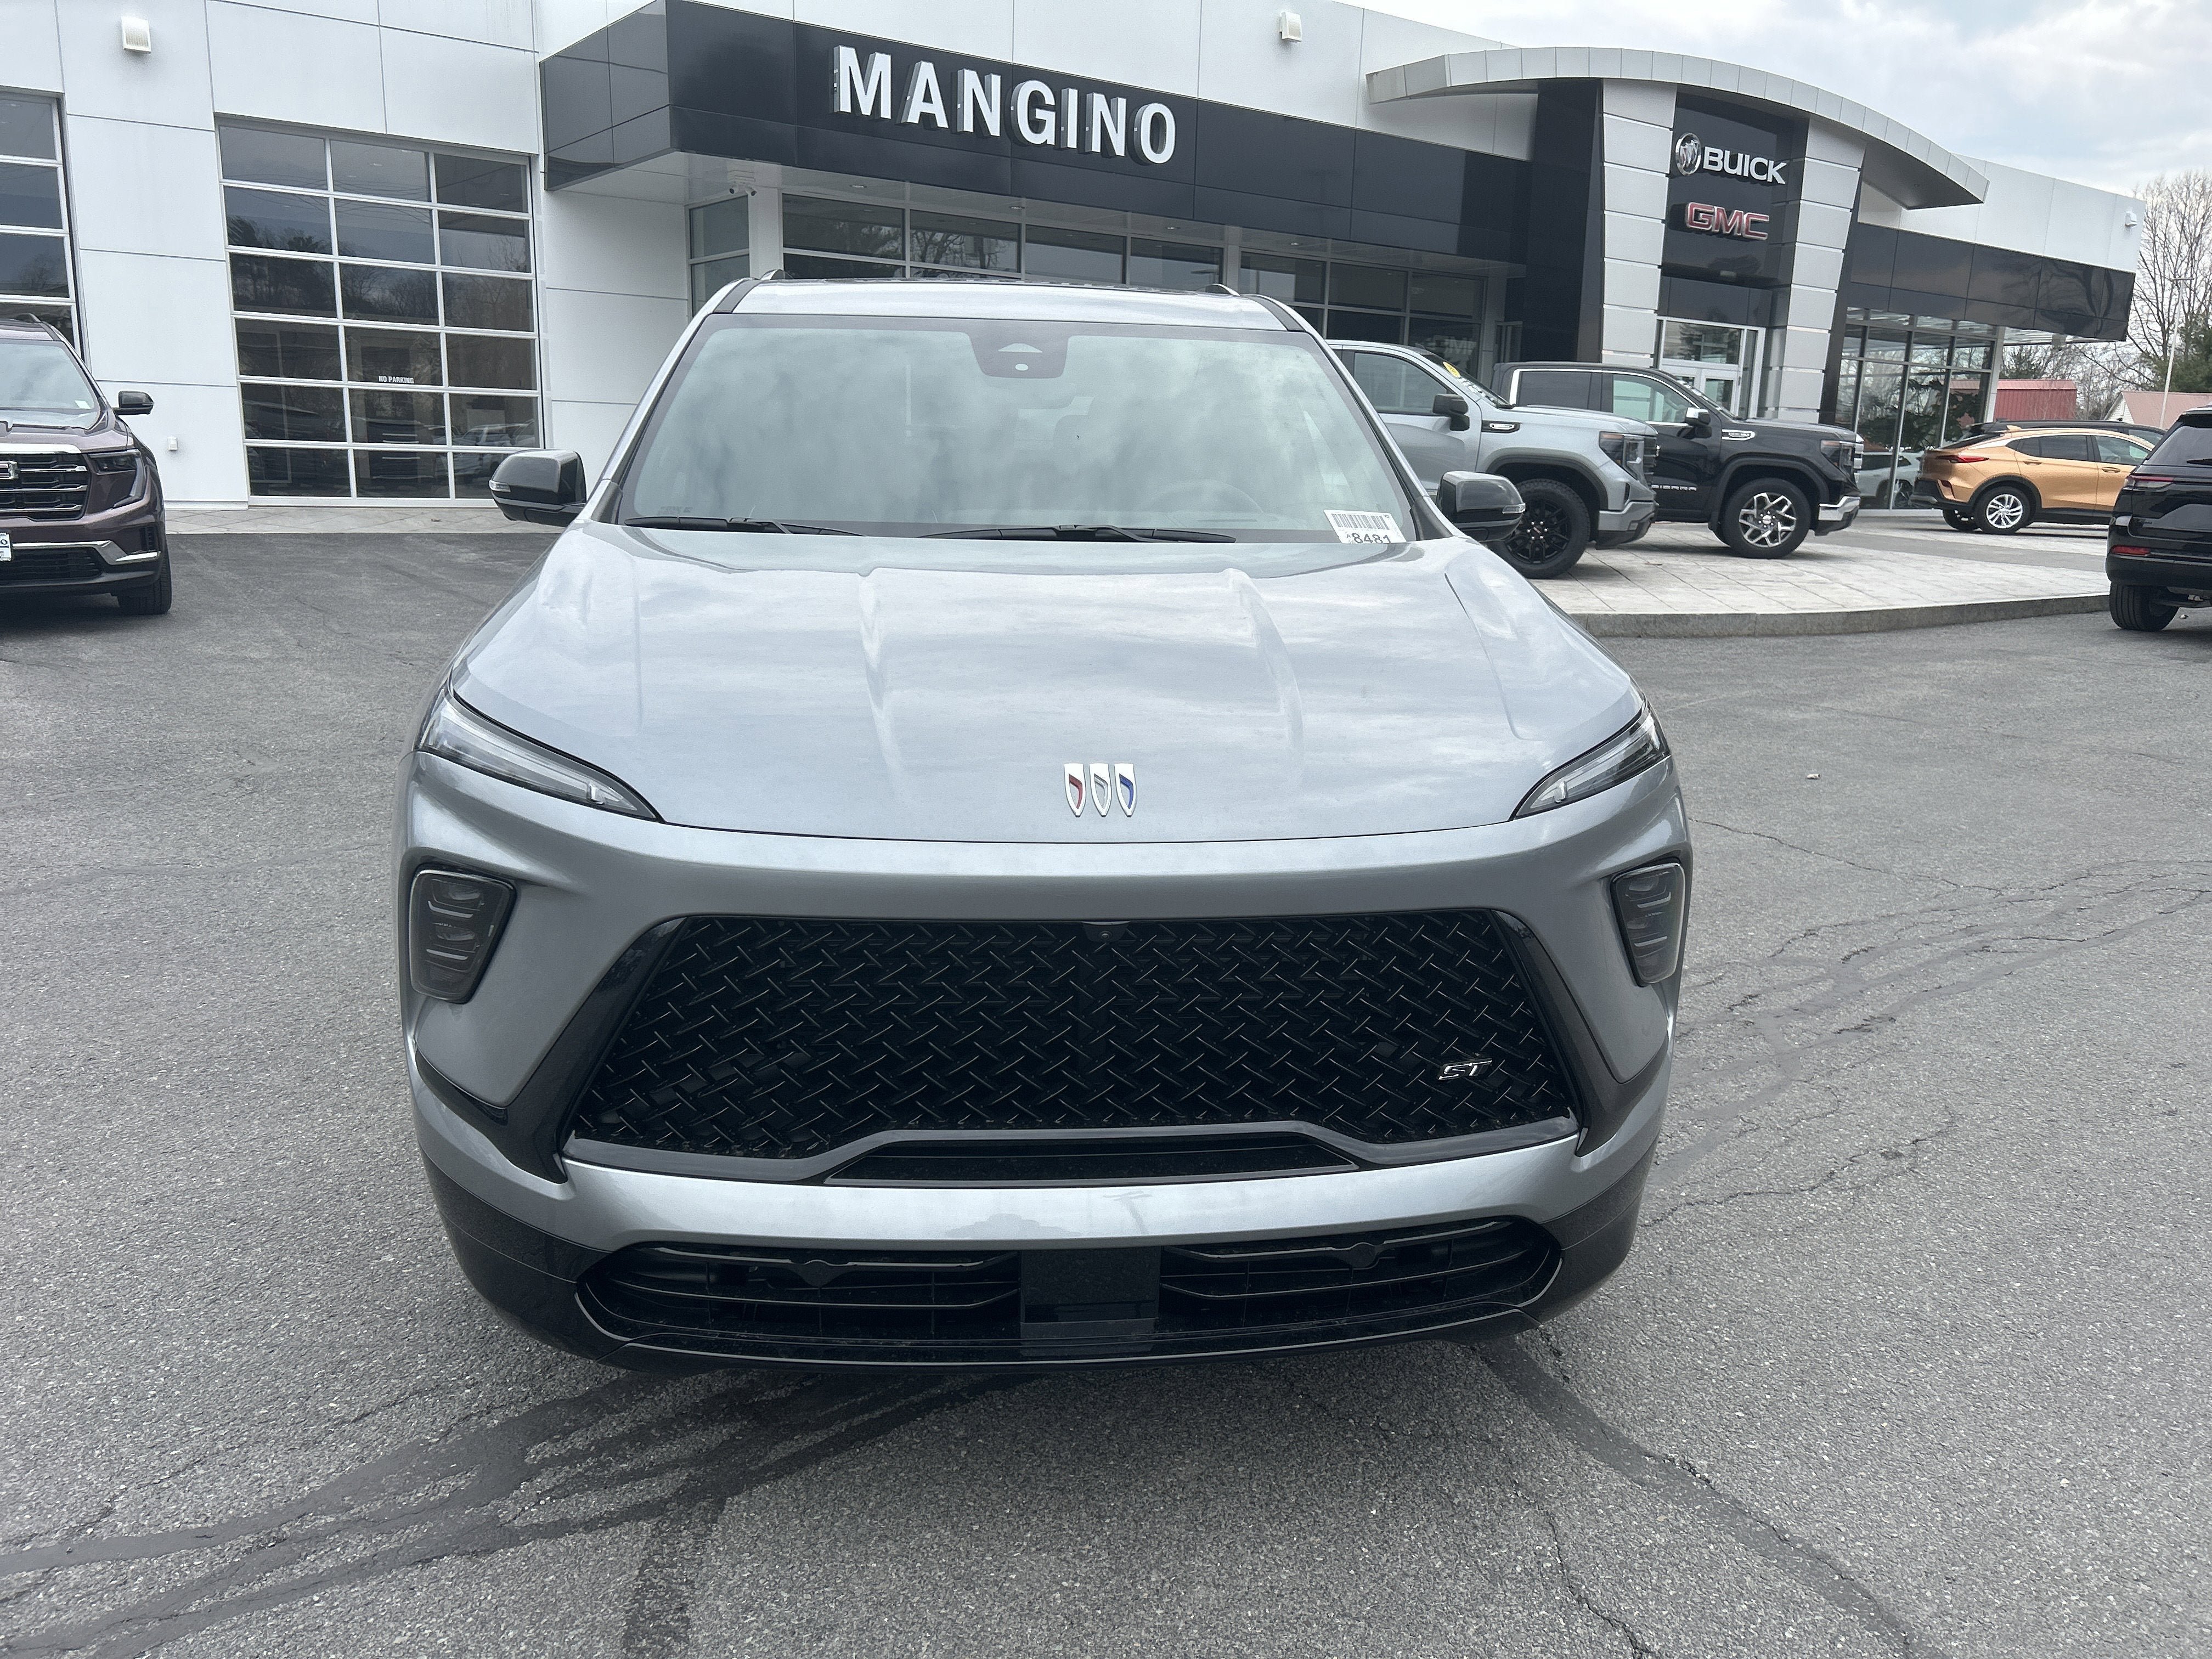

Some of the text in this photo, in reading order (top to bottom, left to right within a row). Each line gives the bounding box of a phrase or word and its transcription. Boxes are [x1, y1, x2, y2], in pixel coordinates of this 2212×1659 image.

[834, 45, 1175, 164] MANGINO
[1703, 146, 1787, 184] BUICK
[1686, 202, 1769, 240] GMC
[1351, 533, 1391, 544] 8481
[1438, 1058, 1492, 1080] ST
